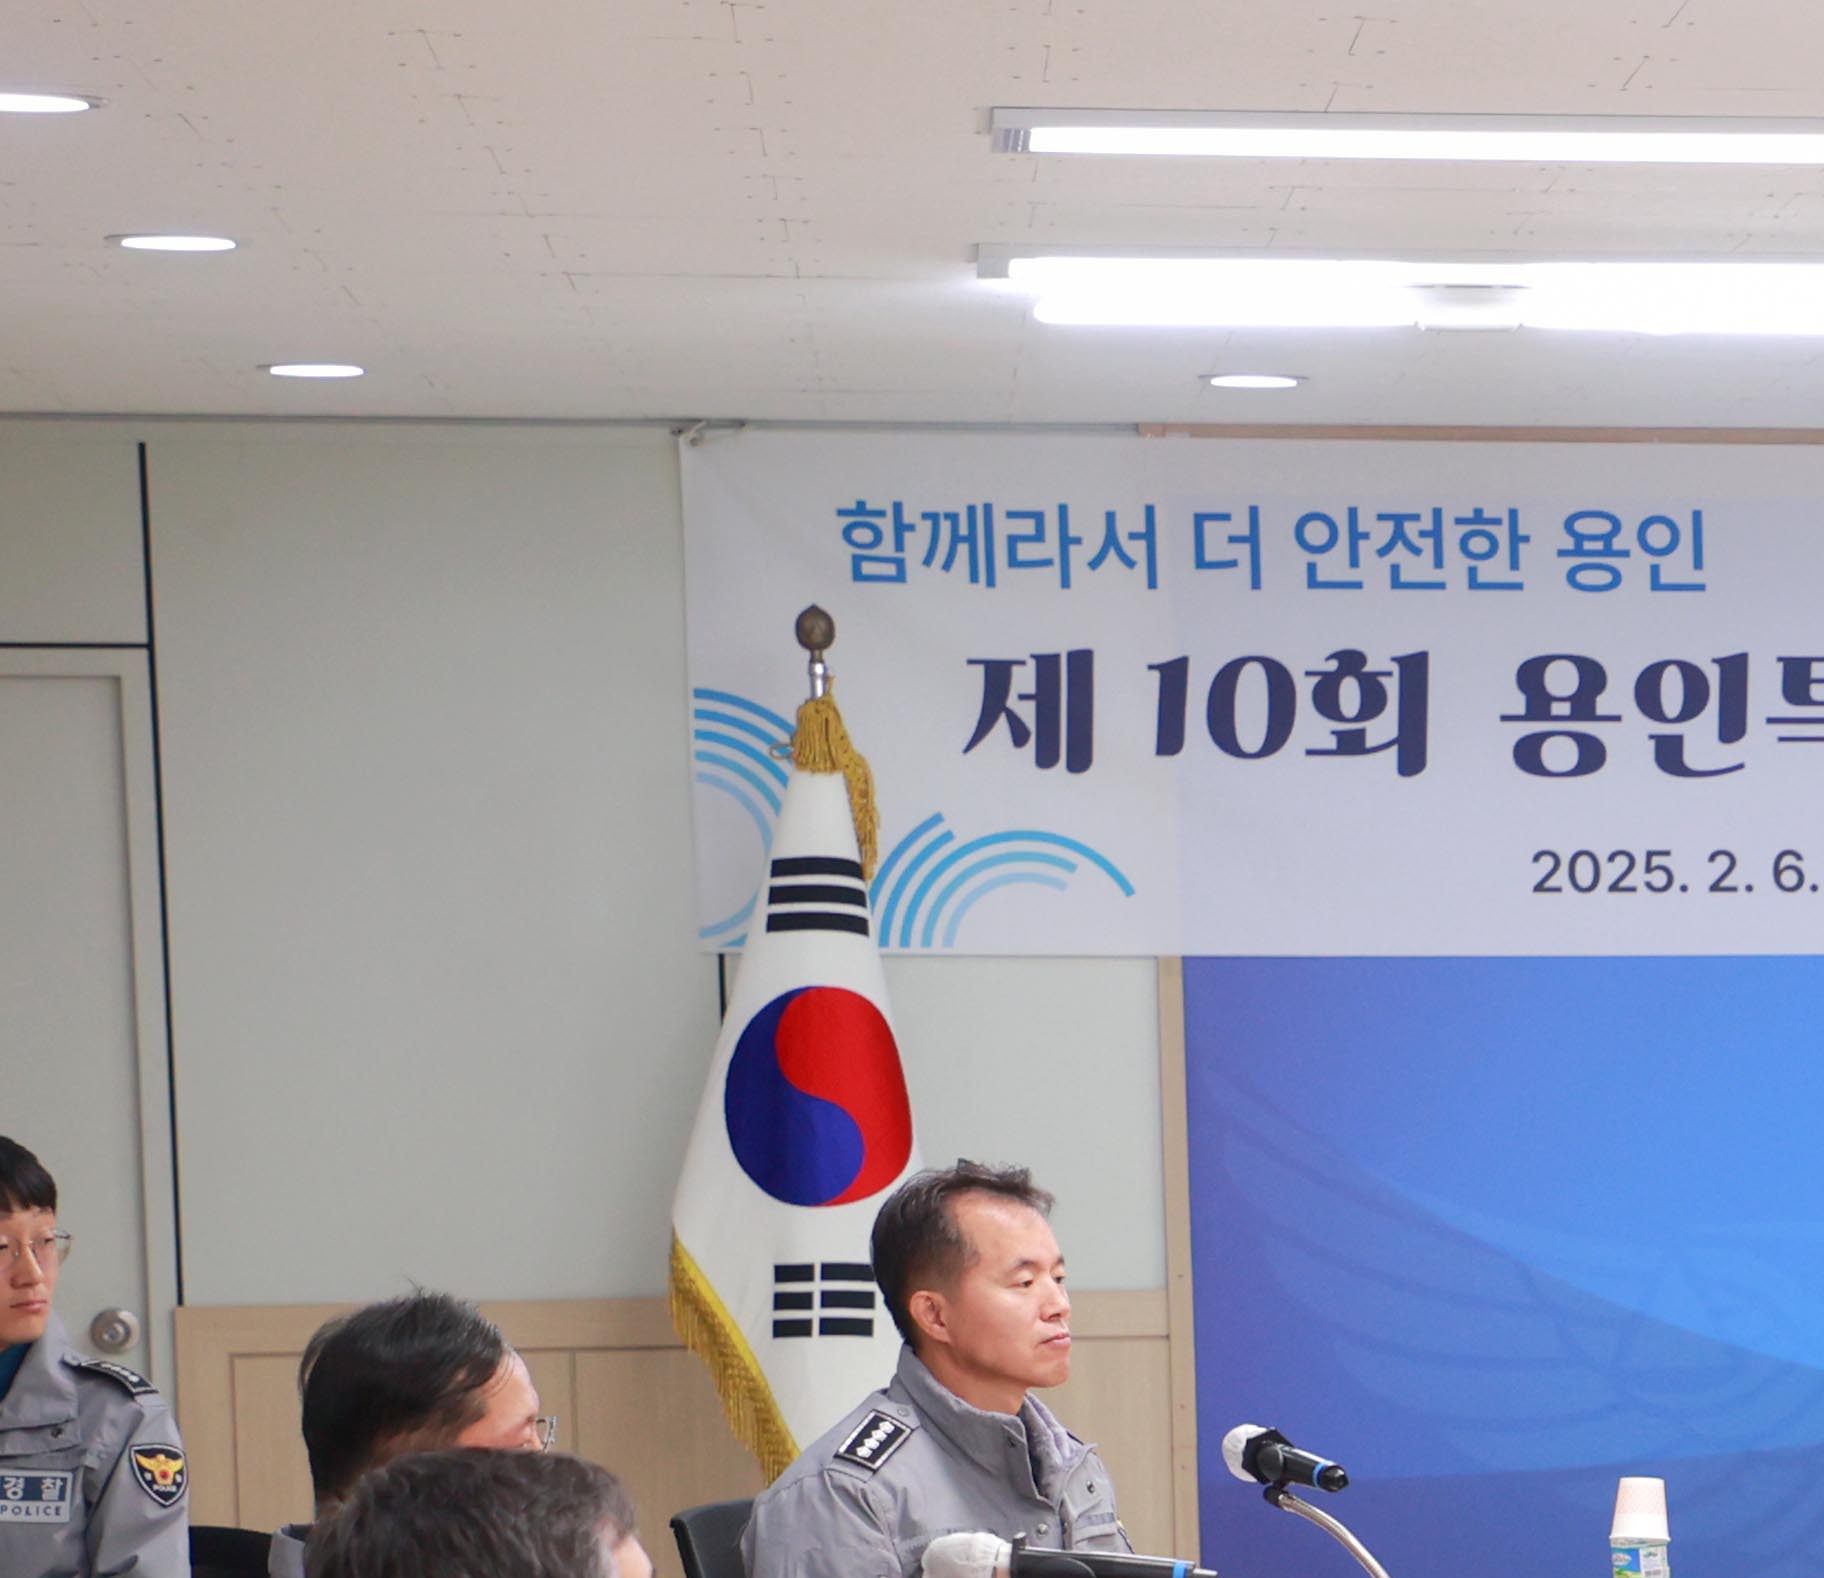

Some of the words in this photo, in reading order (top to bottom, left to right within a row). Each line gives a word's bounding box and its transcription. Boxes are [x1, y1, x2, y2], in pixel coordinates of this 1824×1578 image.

[836, 500, 1158, 590] 함께라서
[1193, 505, 1262, 590] 더
[1293, 501, 1532, 592] 안전한
[1556, 505, 1707, 594] 용인
[963, 649, 1094, 774] 제
[1147, 649, 1429, 777] 10회
[1533, 850, 1688, 893] 2025.
[1708, 850, 1753, 892] 2.
[1773, 850, 1818, 892] 6.
[0, 1504, 61, 1517] POLICE
